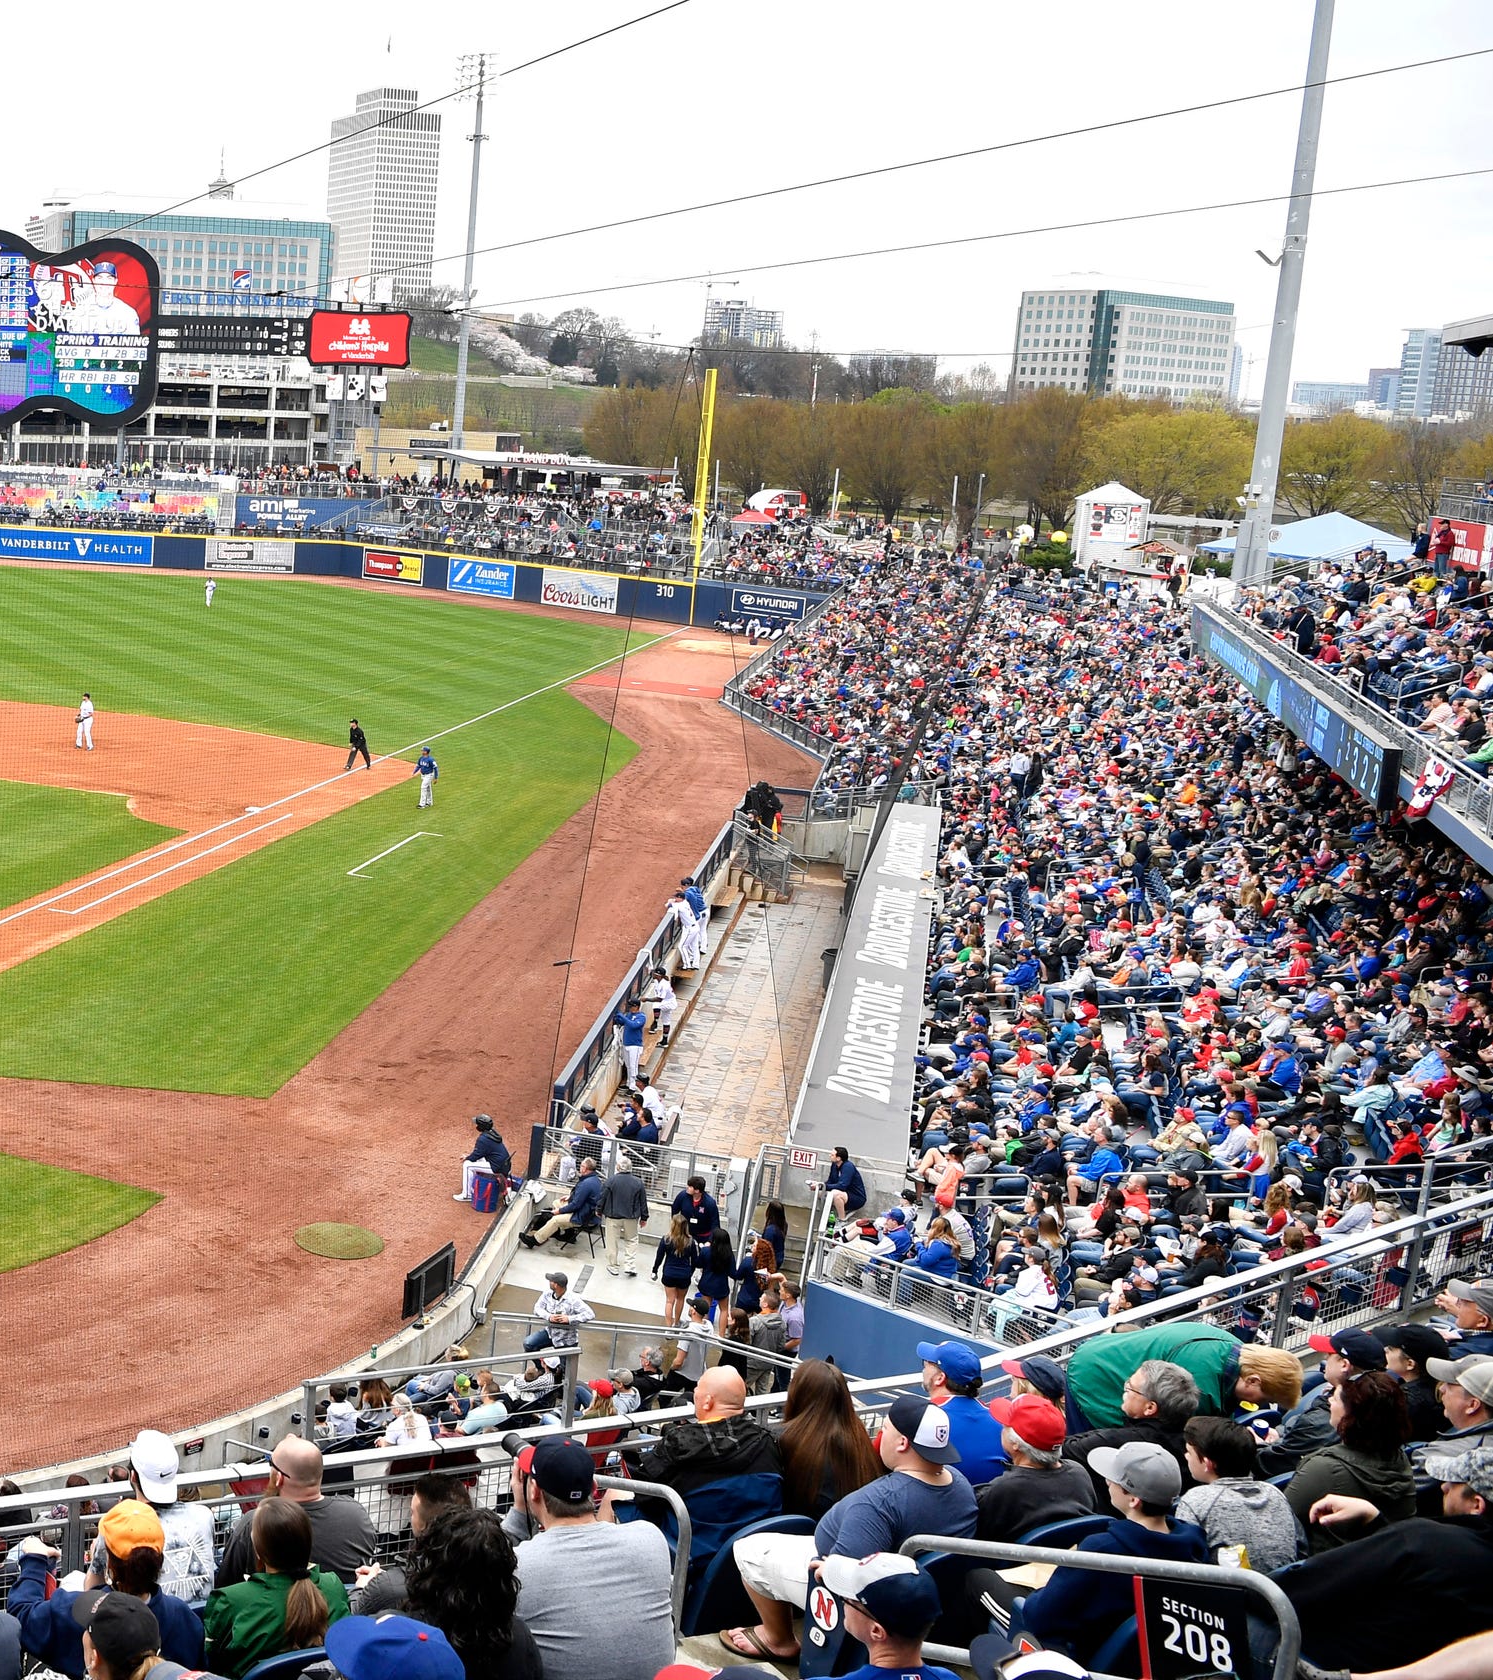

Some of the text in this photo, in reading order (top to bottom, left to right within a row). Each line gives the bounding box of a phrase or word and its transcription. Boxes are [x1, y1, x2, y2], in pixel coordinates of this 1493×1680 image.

[162, 291, 319, 307] FIRST TENNESSEE PARK
[282, 319, 289, 329] 3
[56, 335, 150, 347] SPRING TRAINING
[281, 332, 288, 342] 2
[157, 340, 176, 349] SOUNDS
[281, 345, 288, 355] 2
[293, 341, 306, 350] 92
[361, 341, 390, 352] Hospital
[57, 348, 78, 356] AVG
[115, 350, 128, 358] 2B
[132, 350, 146, 358] 3B
[347, 352, 375, 360] Vanderbilt
[29, 338, 52, 395] TEX
[56, 359, 143, 370] .250 4 6 2 1
[61, 373, 137, 383] HR RBI BB SB
[65, 384, 133, 395] 0 0 4 1
[522, 452, 570, 466] BAND BOX
[120, 479, 149, 488] PLACE
[249, 499, 283, 513] ami
[288, 507, 316, 515] Marketing
[285, 513, 308, 521] ALLEY
[1, 537, 143, 555] VANDERBILT HEALTH
[218, 542, 253, 551] Electronic
[218, 551, 249, 560] Express
[368, 560, 394, 571] Thompson
[475, 565, 510, 581] Zander
[543, 583, 615, 610] Coors LIGHT
[656, 586, 674, 598] 310
[756, 596, 798, 610] HYUNDAI
[1350, 746, 1379, 800] 3 2 2
[877, 817, 928, 880] BRIDGESTONE
[856, 884, 918, 971] BRIDGESTONE
[826, 977, 905, 1105] BRIDGESTONE
[793, 1151, 813, 1164] EXIT
[815, 1589, 834, 1628] N
[1162, 1596, 1225, 1631] SECTION
[813, 1631, 821, 1642] B
[1161, 1613, 1233, 1673] 208
